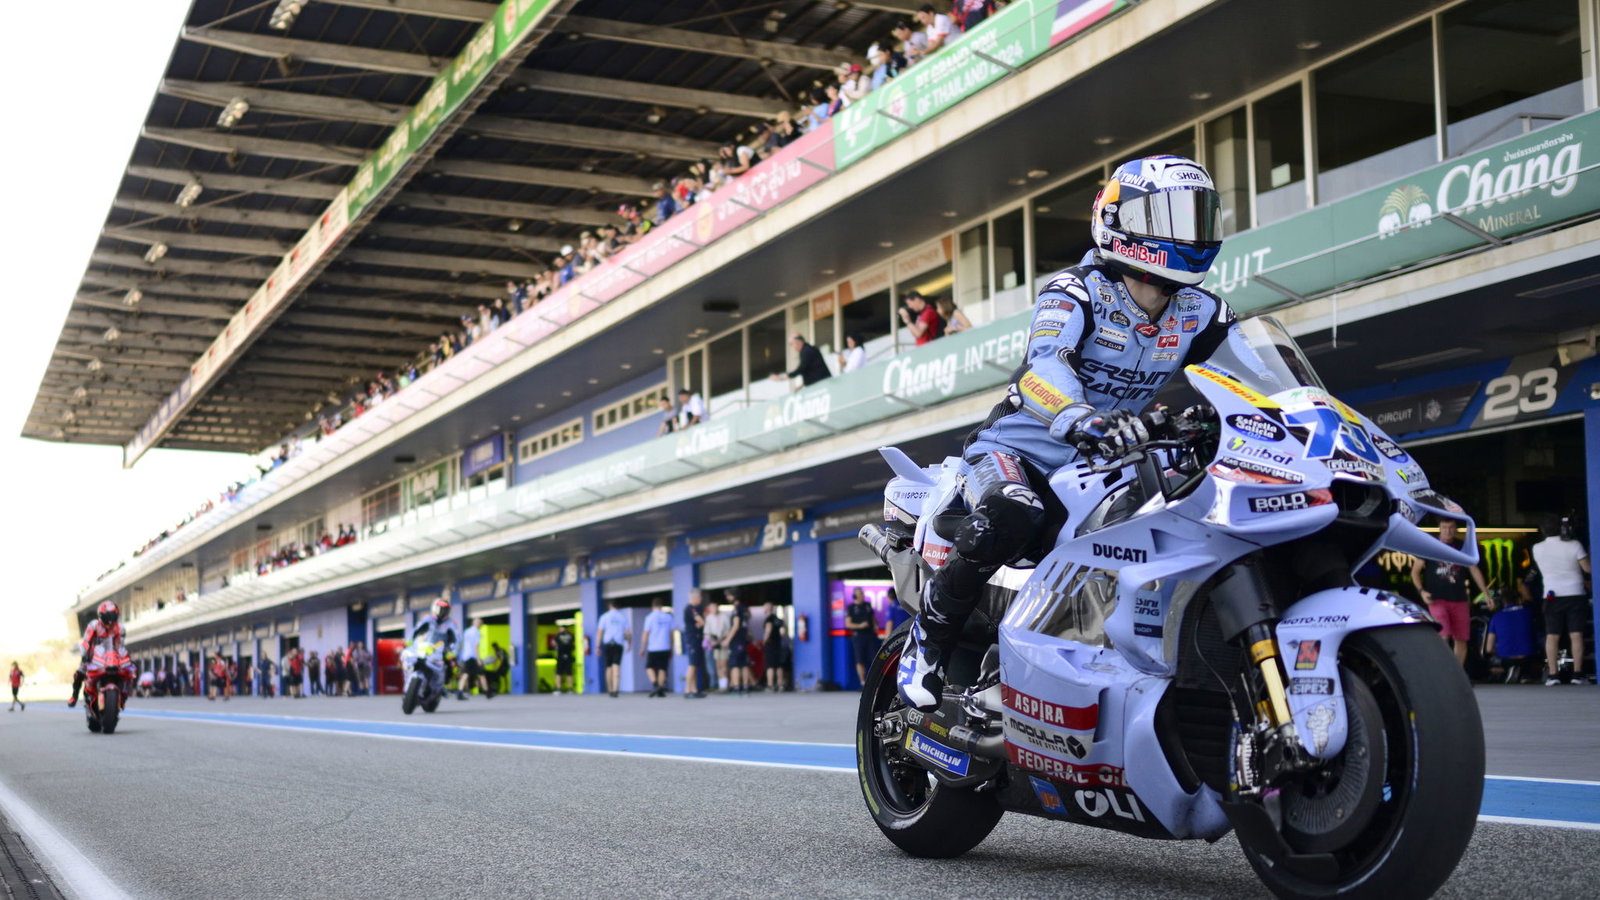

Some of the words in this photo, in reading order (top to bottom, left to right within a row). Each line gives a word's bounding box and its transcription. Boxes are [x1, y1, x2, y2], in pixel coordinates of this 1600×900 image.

[917, 94, 930, 117] OF
[932, 61, 988, 107] THAILAND
[1436, 141, 1583, 217] Chang
[1479, 205, 1541, 233] MINERAL
[1113, 237, 1137, 260] Red
[1137, 245, 1168, 268] Bull
[882, 353, 958, 403] Chang
[964, 327, 1031, 375] INTER
[1207, 247, 1272, 294] CUIT
[1483, 367, 1558, 421] 23
[1377, 407, 1413, 425] CIRCUIT
[1255, 492, 1306, 509] BOLD
[764, 521, 787, 545] 20
[1092, 543, 1147, 563] DUCATI
[1281, 615, 1350, 625] MOTO-TRON
[1292, 683, 1329, 695] SIPEX
[1015, 693, 1064, 724] ASPIRA
[1009, 717, 1066, 747] MODULA
[920, 742, 962, 767] MICHELIN
[1017, 748, 1089, 784] FEDERAL
